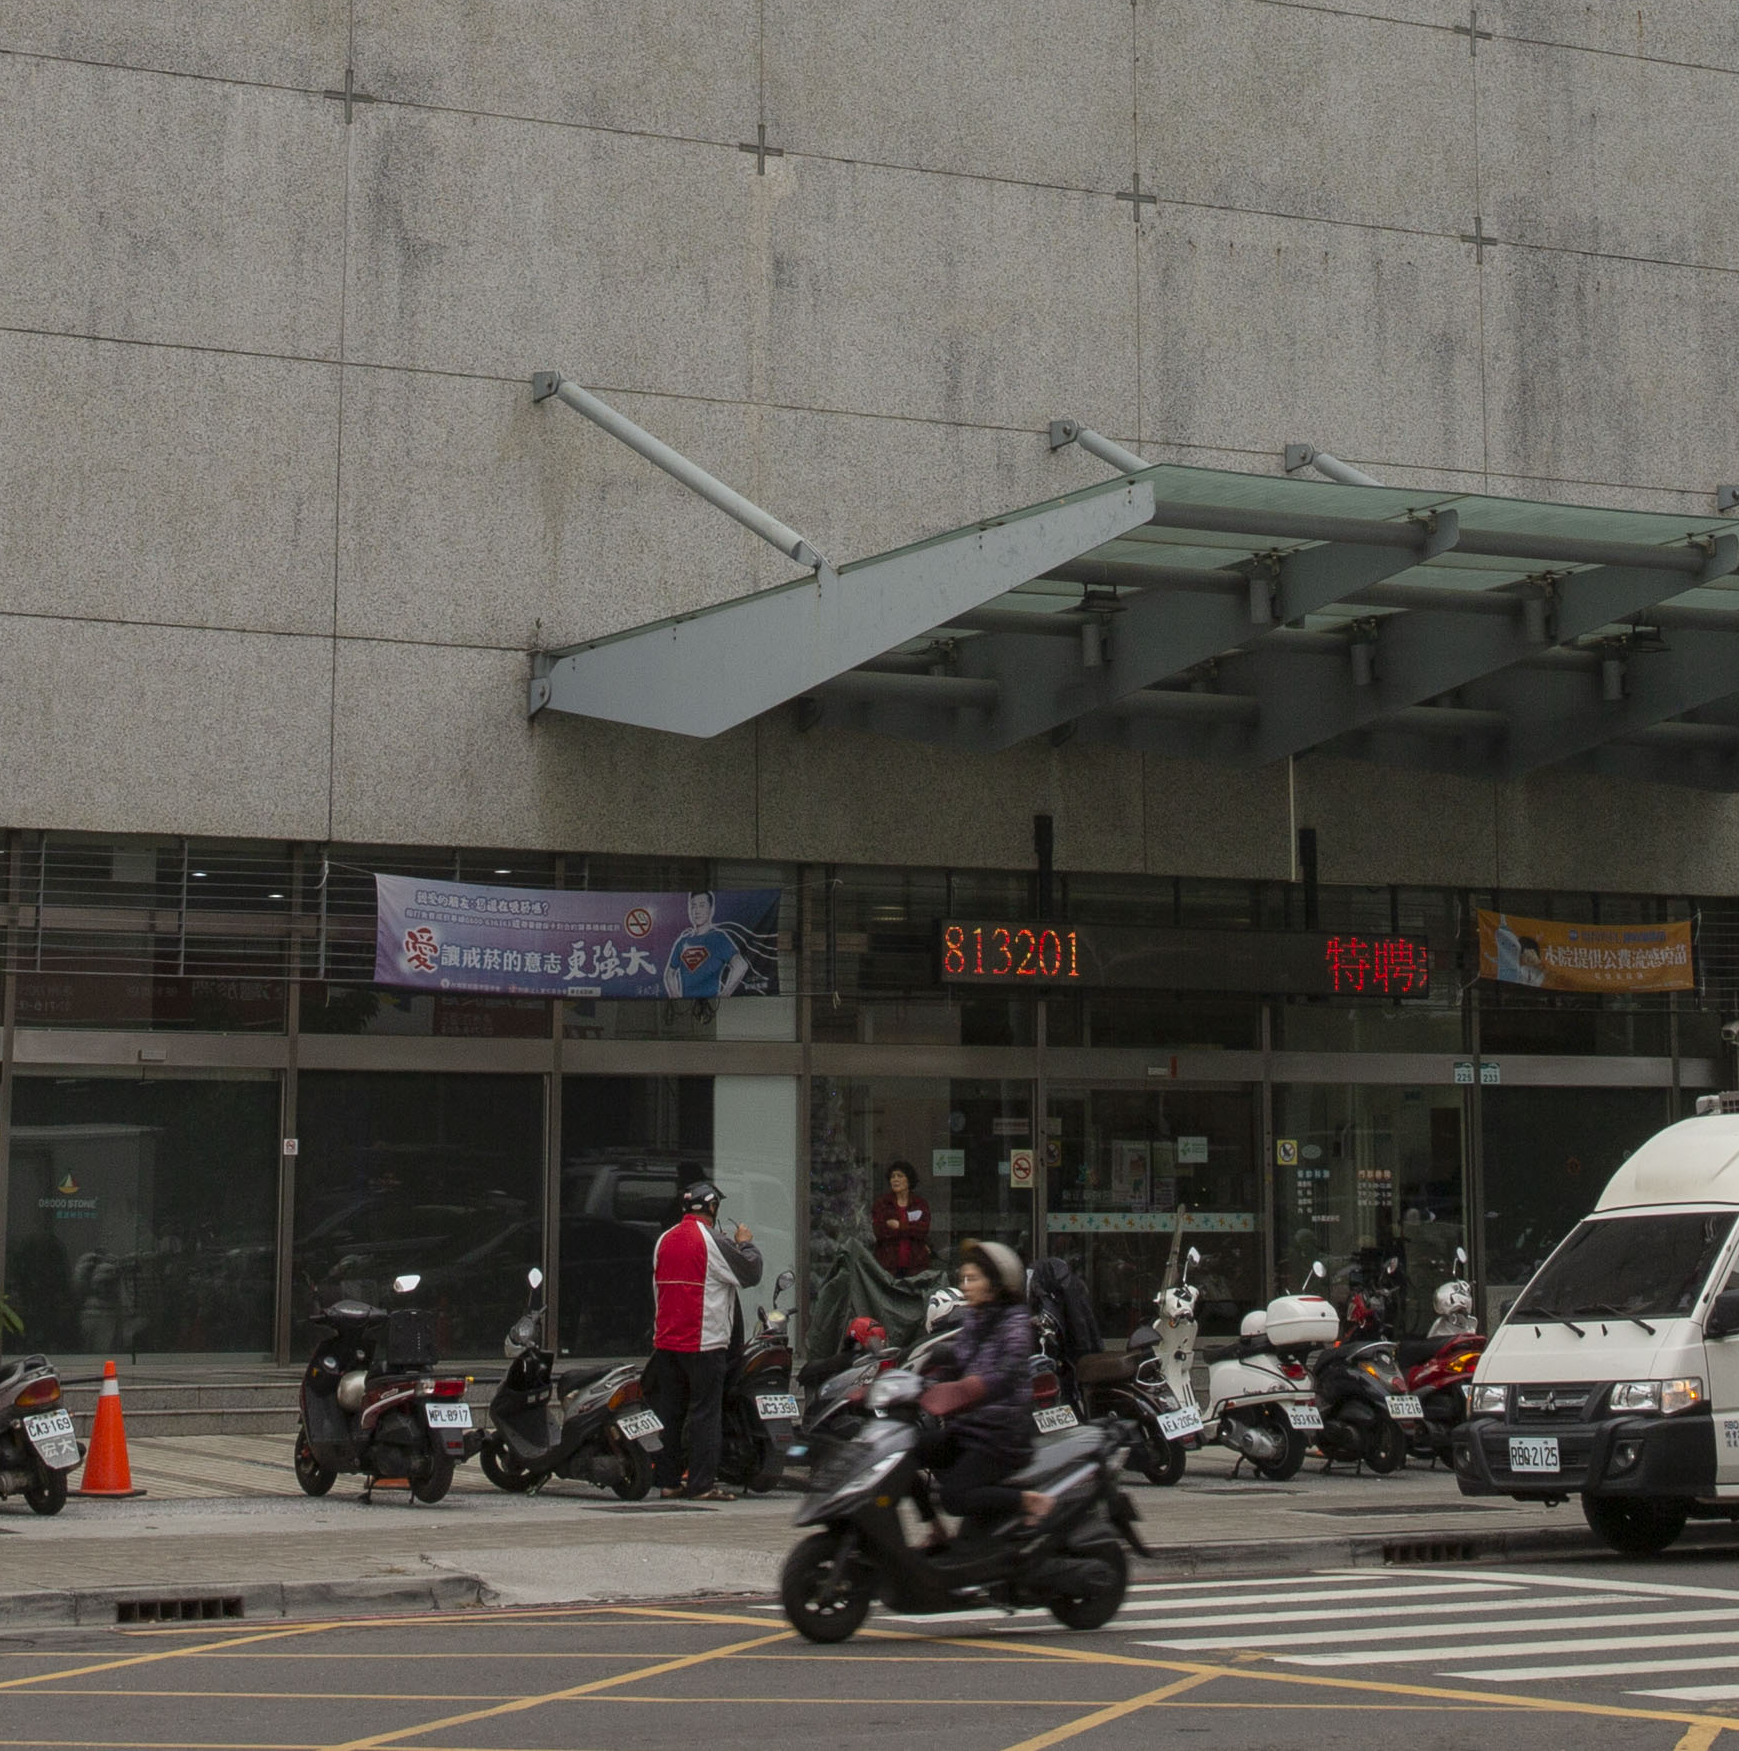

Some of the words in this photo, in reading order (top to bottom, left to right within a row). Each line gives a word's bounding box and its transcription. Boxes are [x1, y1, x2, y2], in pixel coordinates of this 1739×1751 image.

[944, 926, 1080, 978] 813201
[1326, 936, 1428, 993] 特聘
[28, 1418, 71, 1438] CA3-169
